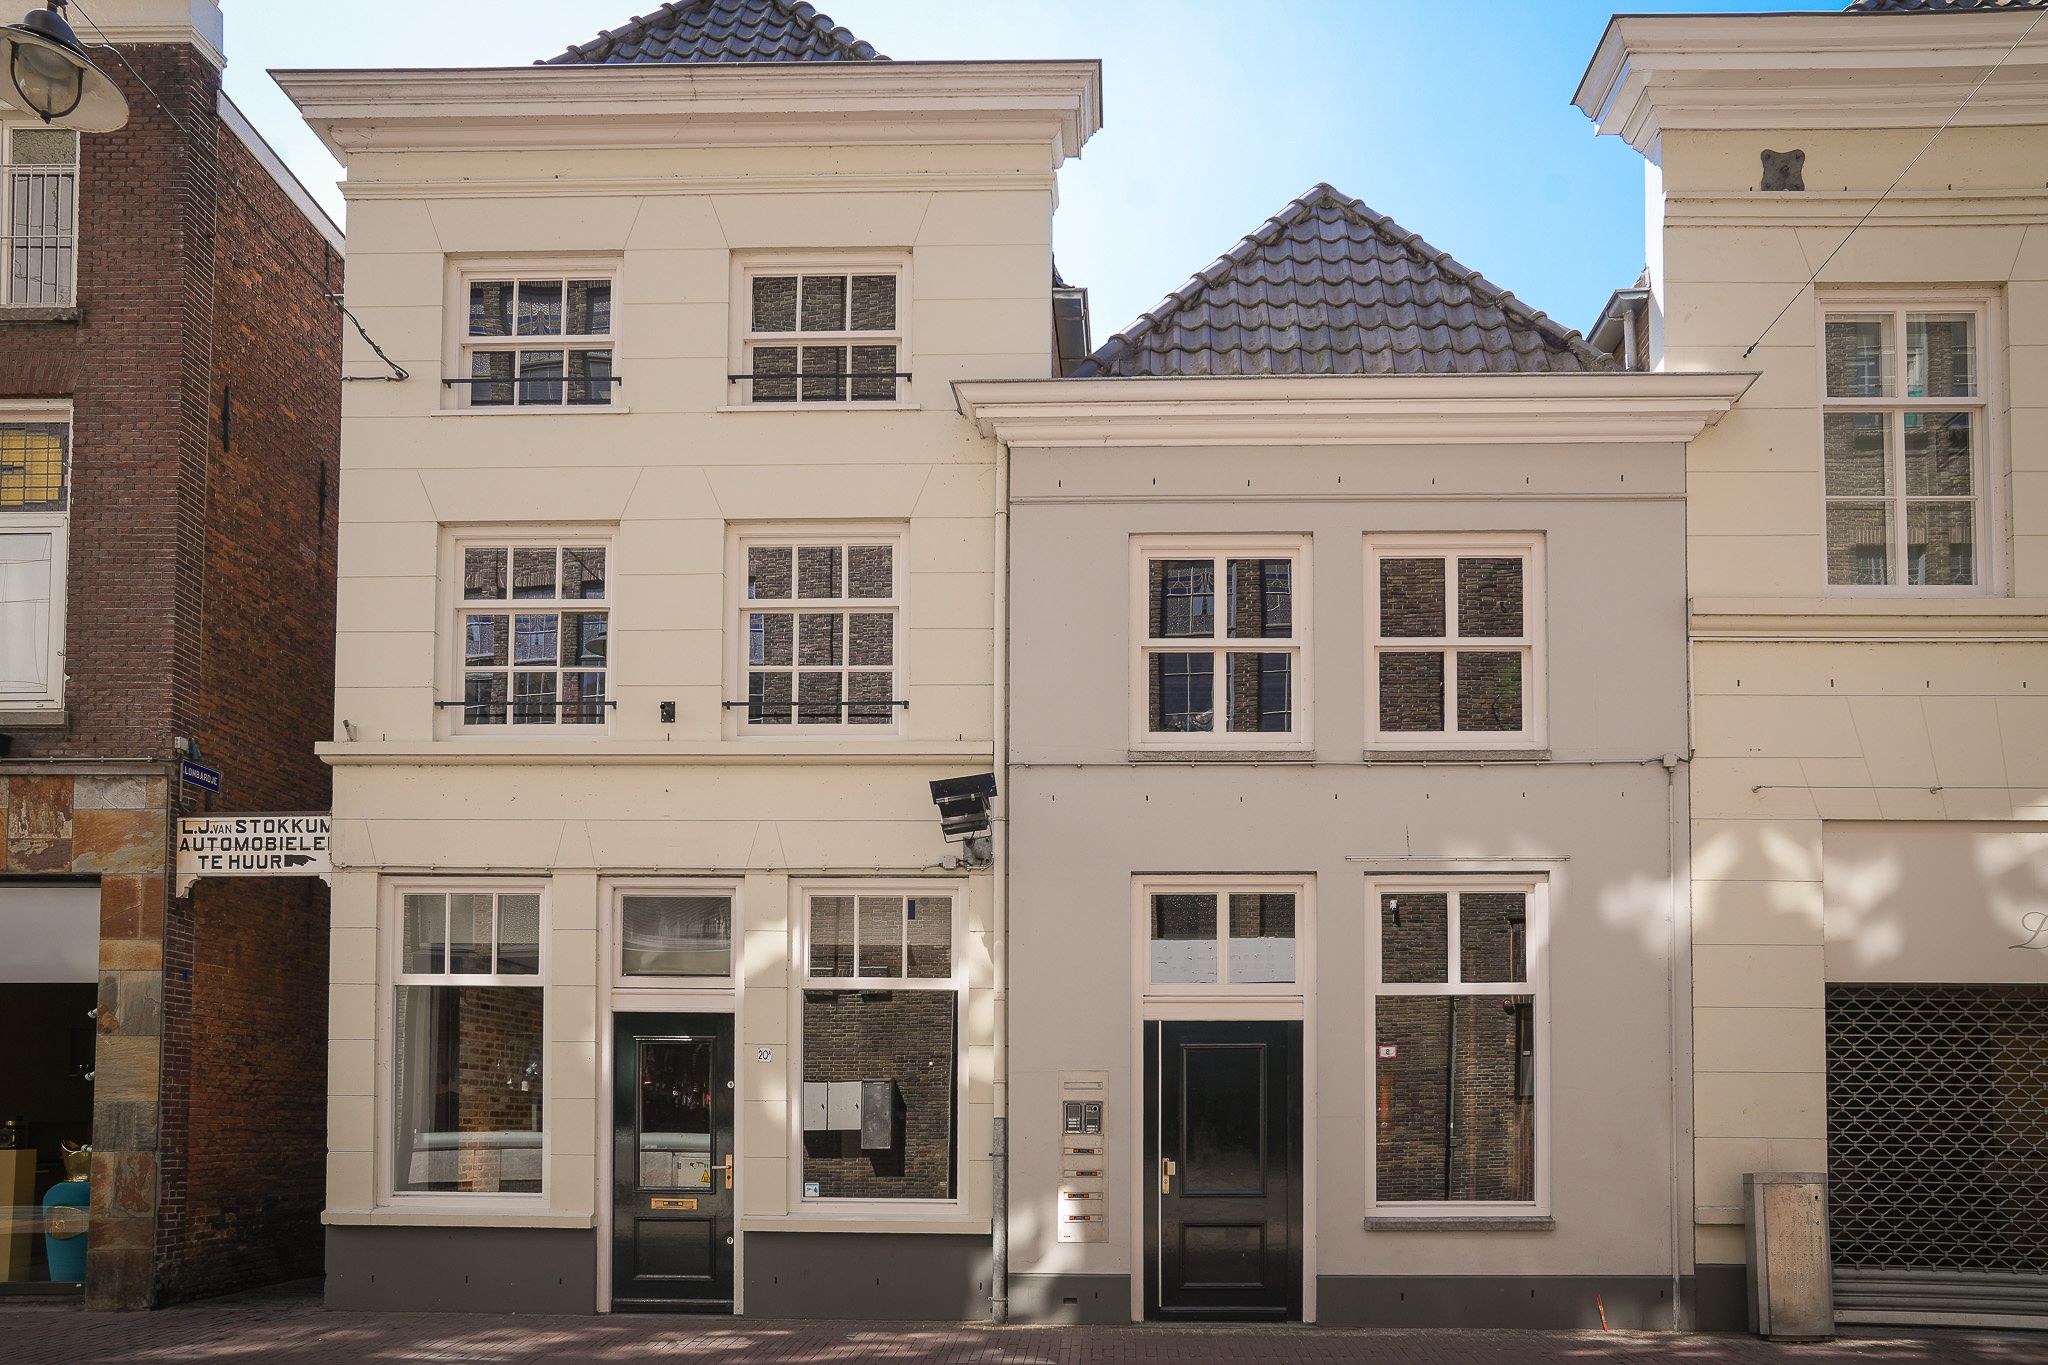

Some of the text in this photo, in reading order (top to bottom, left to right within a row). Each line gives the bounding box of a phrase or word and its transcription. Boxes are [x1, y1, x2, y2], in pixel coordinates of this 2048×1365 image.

[179, 837, 330, 851] AUTOMOBIELE
[198, 854, 282, 870] TE HUUR
